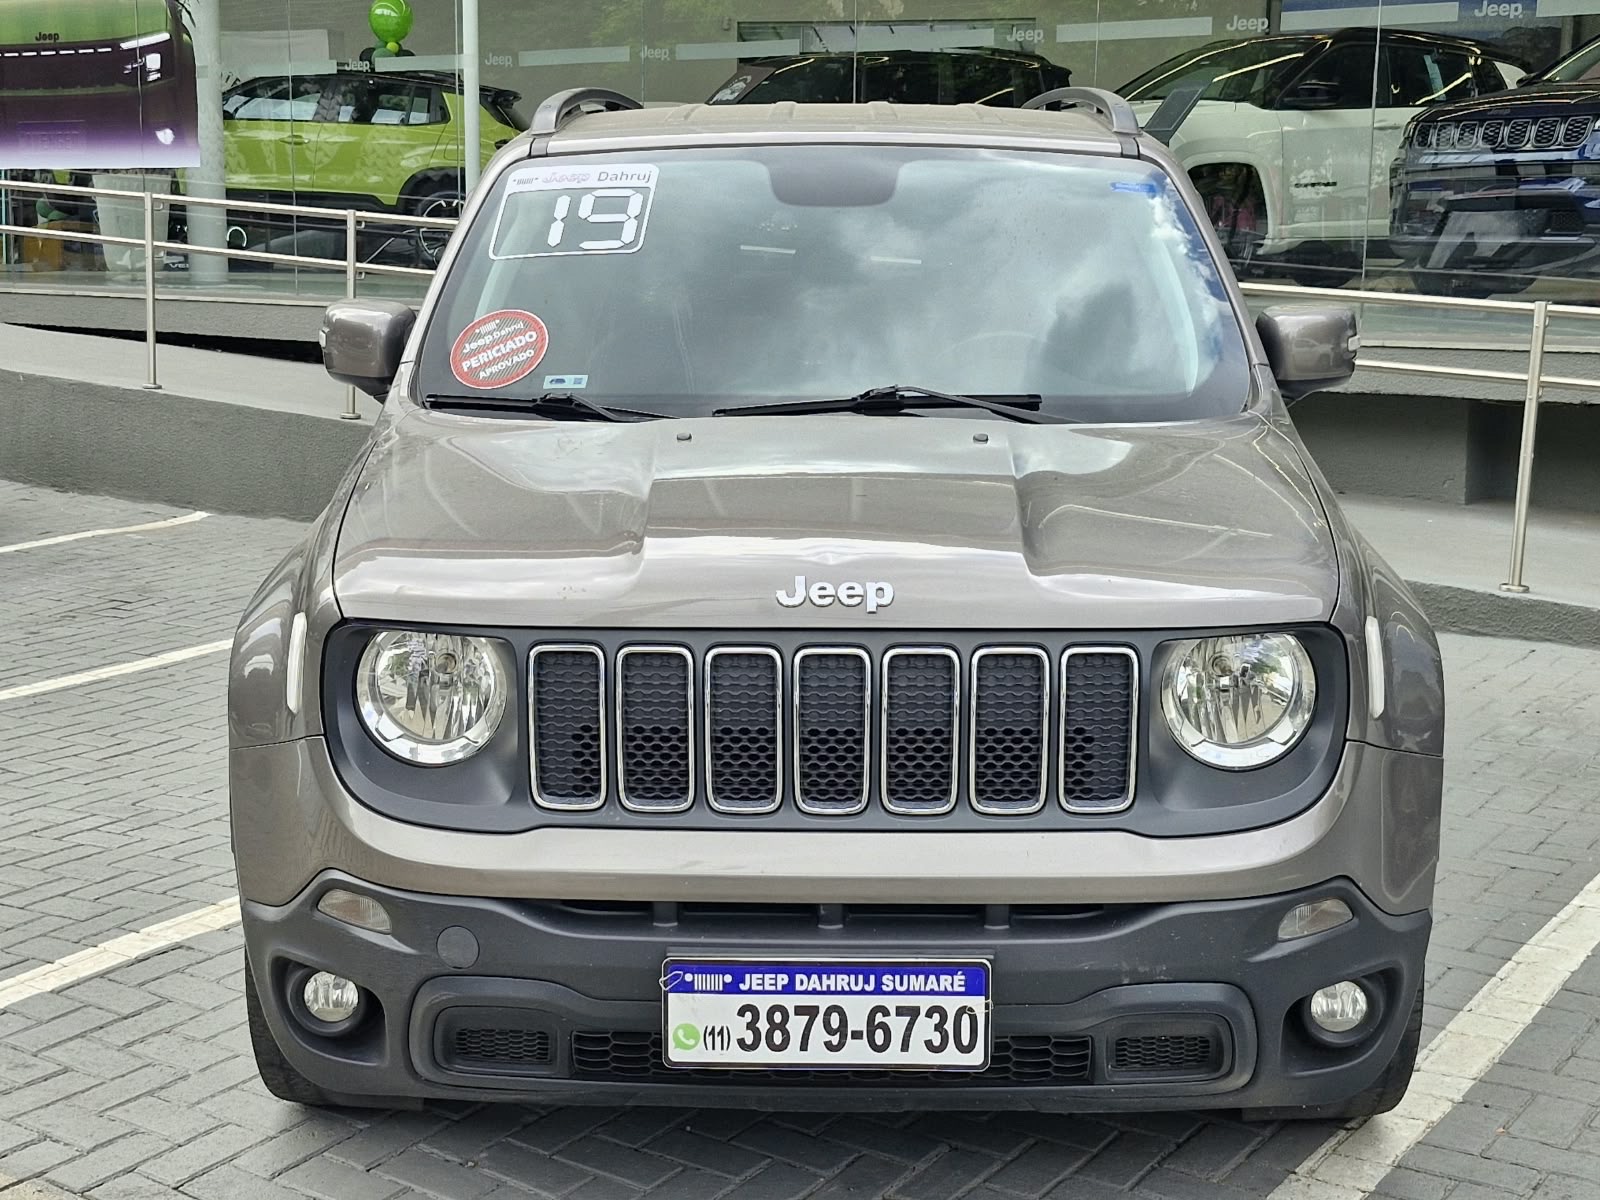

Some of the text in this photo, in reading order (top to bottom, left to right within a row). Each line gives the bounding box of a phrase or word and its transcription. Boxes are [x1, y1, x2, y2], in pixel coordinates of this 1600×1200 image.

[1475, 0, 1523, 19] Jeep
[1226, 15, 1270, 33] Jeep
[35, 31, 60, 42] Jeep
[1006, 26, 1045, 44] Jeep
[485, 52, 513, 68] Jeep
[641, 46, 670, 62] Jeep
[345, 59, 371, 73] Jeep
[596, 171, 652, 184] Dahruj
[547, 188, 644, 250] 19
[461, 330, 538, 372] PERICIADO
[479, 349, 535, 380] APROVADO
[775, 575, 895, 614] Jeep
[739, 970, 966, 991] JEEP DAHRUJ SUMARÉ
[703, 1003, 980, 1055] (11) 3879-6730
